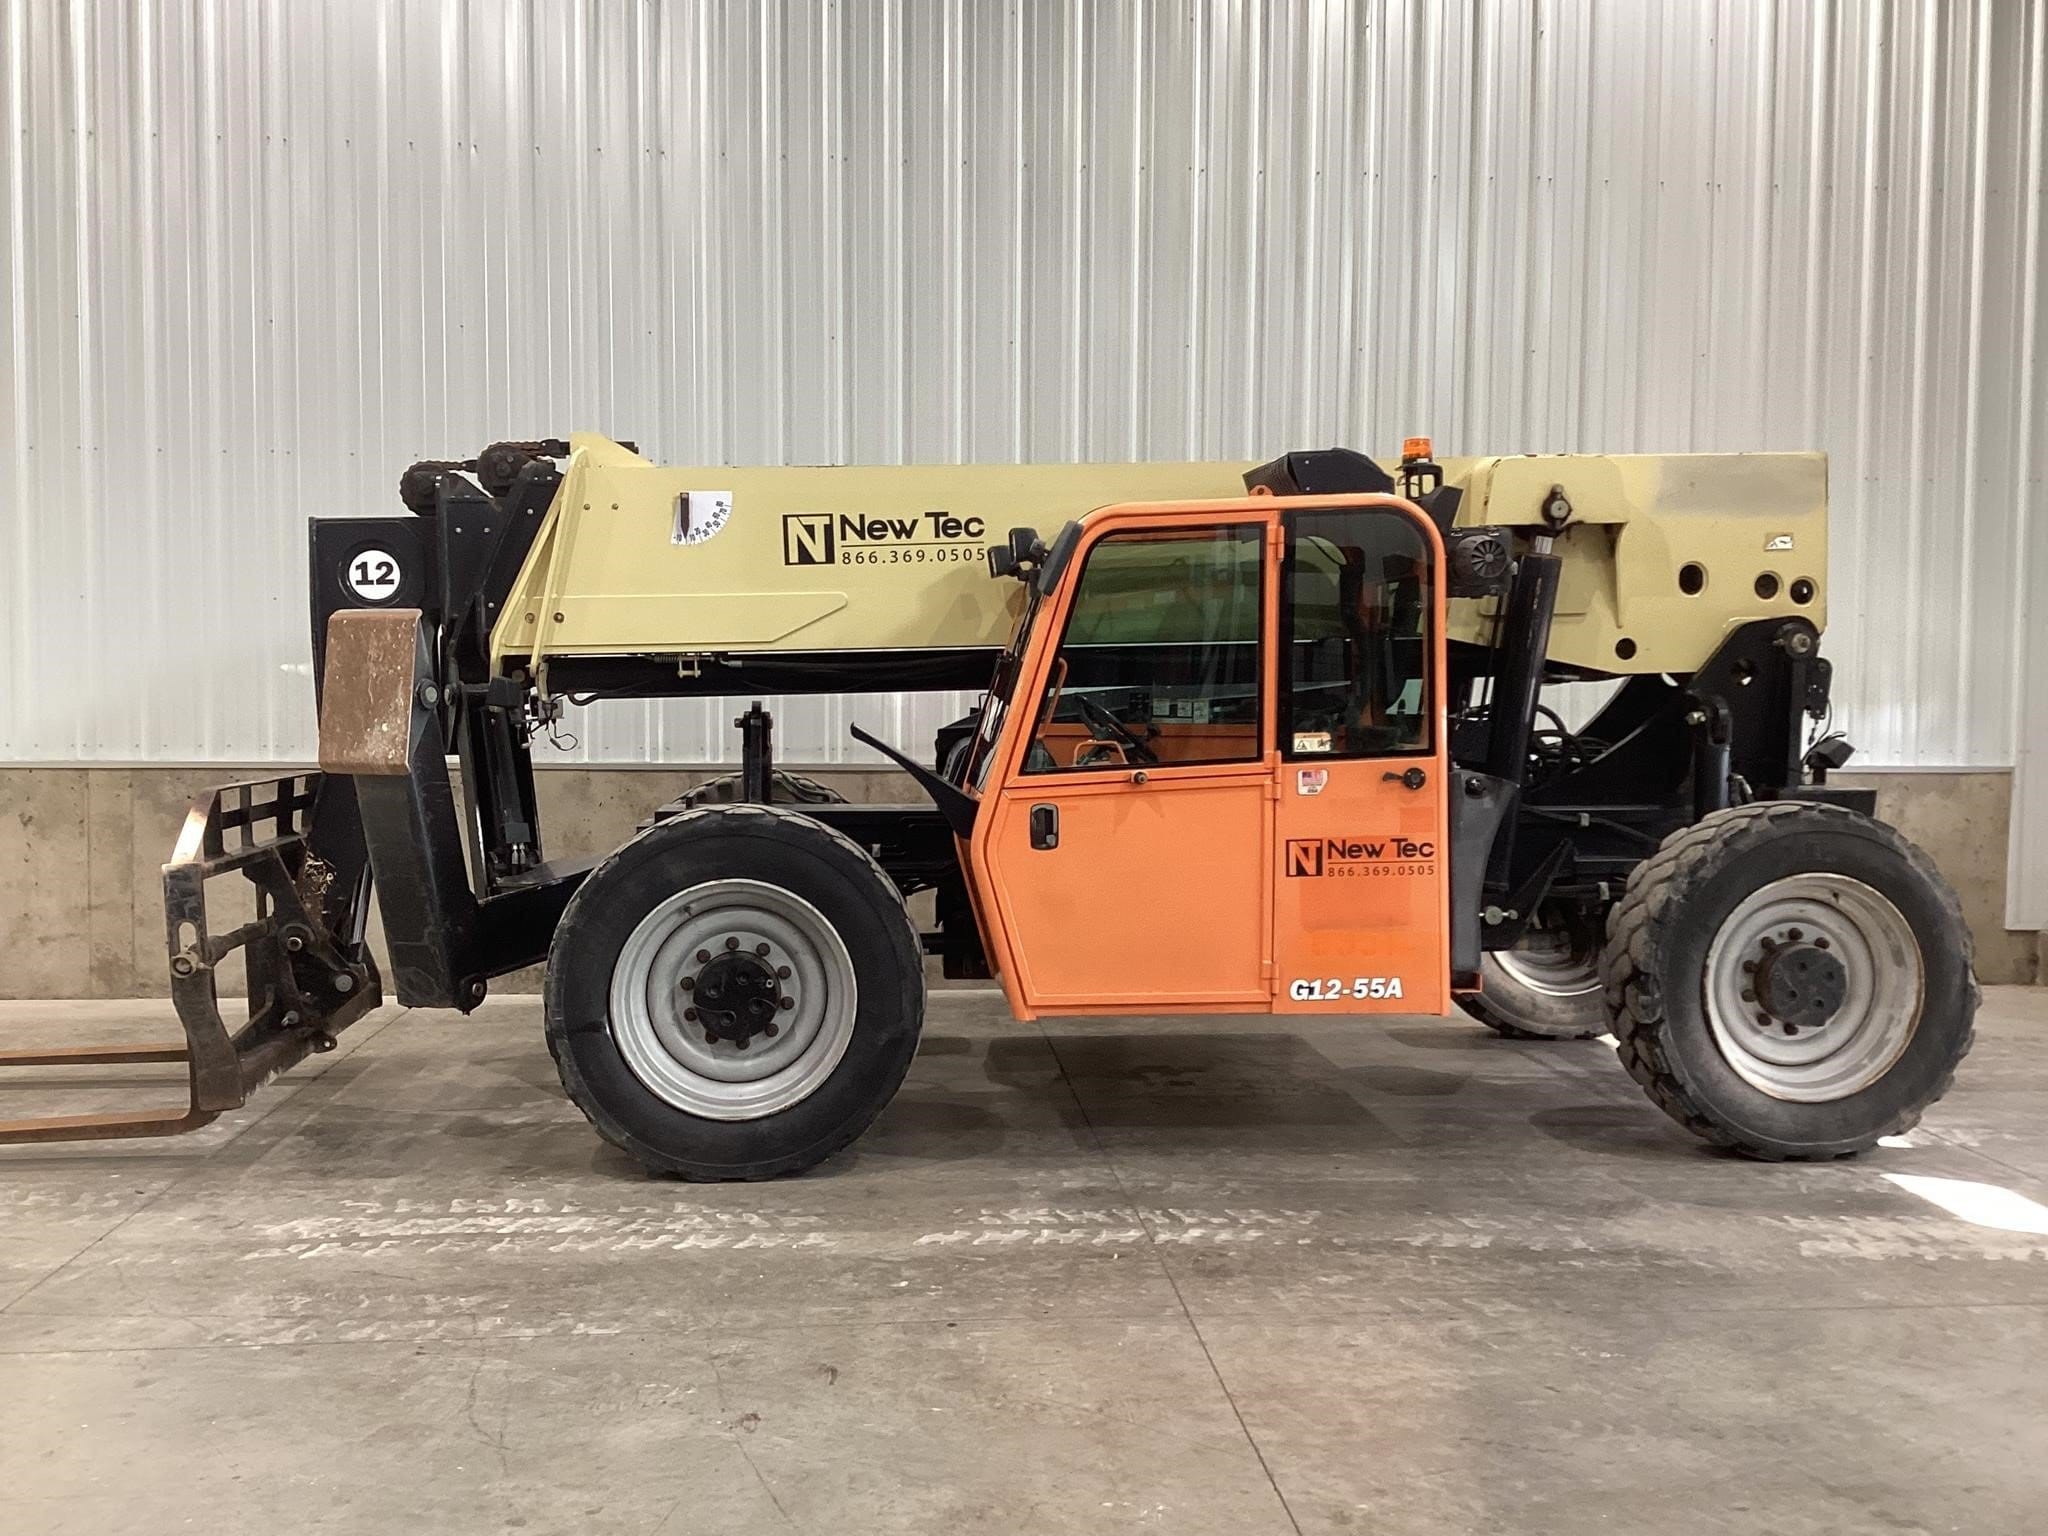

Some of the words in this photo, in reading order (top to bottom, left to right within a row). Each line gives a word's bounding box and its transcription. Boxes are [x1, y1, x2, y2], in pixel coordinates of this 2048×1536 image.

[839, 513, 919, 541] New
[924, 512, 985, 539] Tec
[842, 548, 985, 565] 866.369.0505
[355, 561, 395, 585] 12
[1328, 839, 1385, 860] New
[1390, 838, 1434, 858] Tec
[1328, 865, 1434, 877] 866.369.0505
[1290, 977, 1403, 1001] G12-55A
